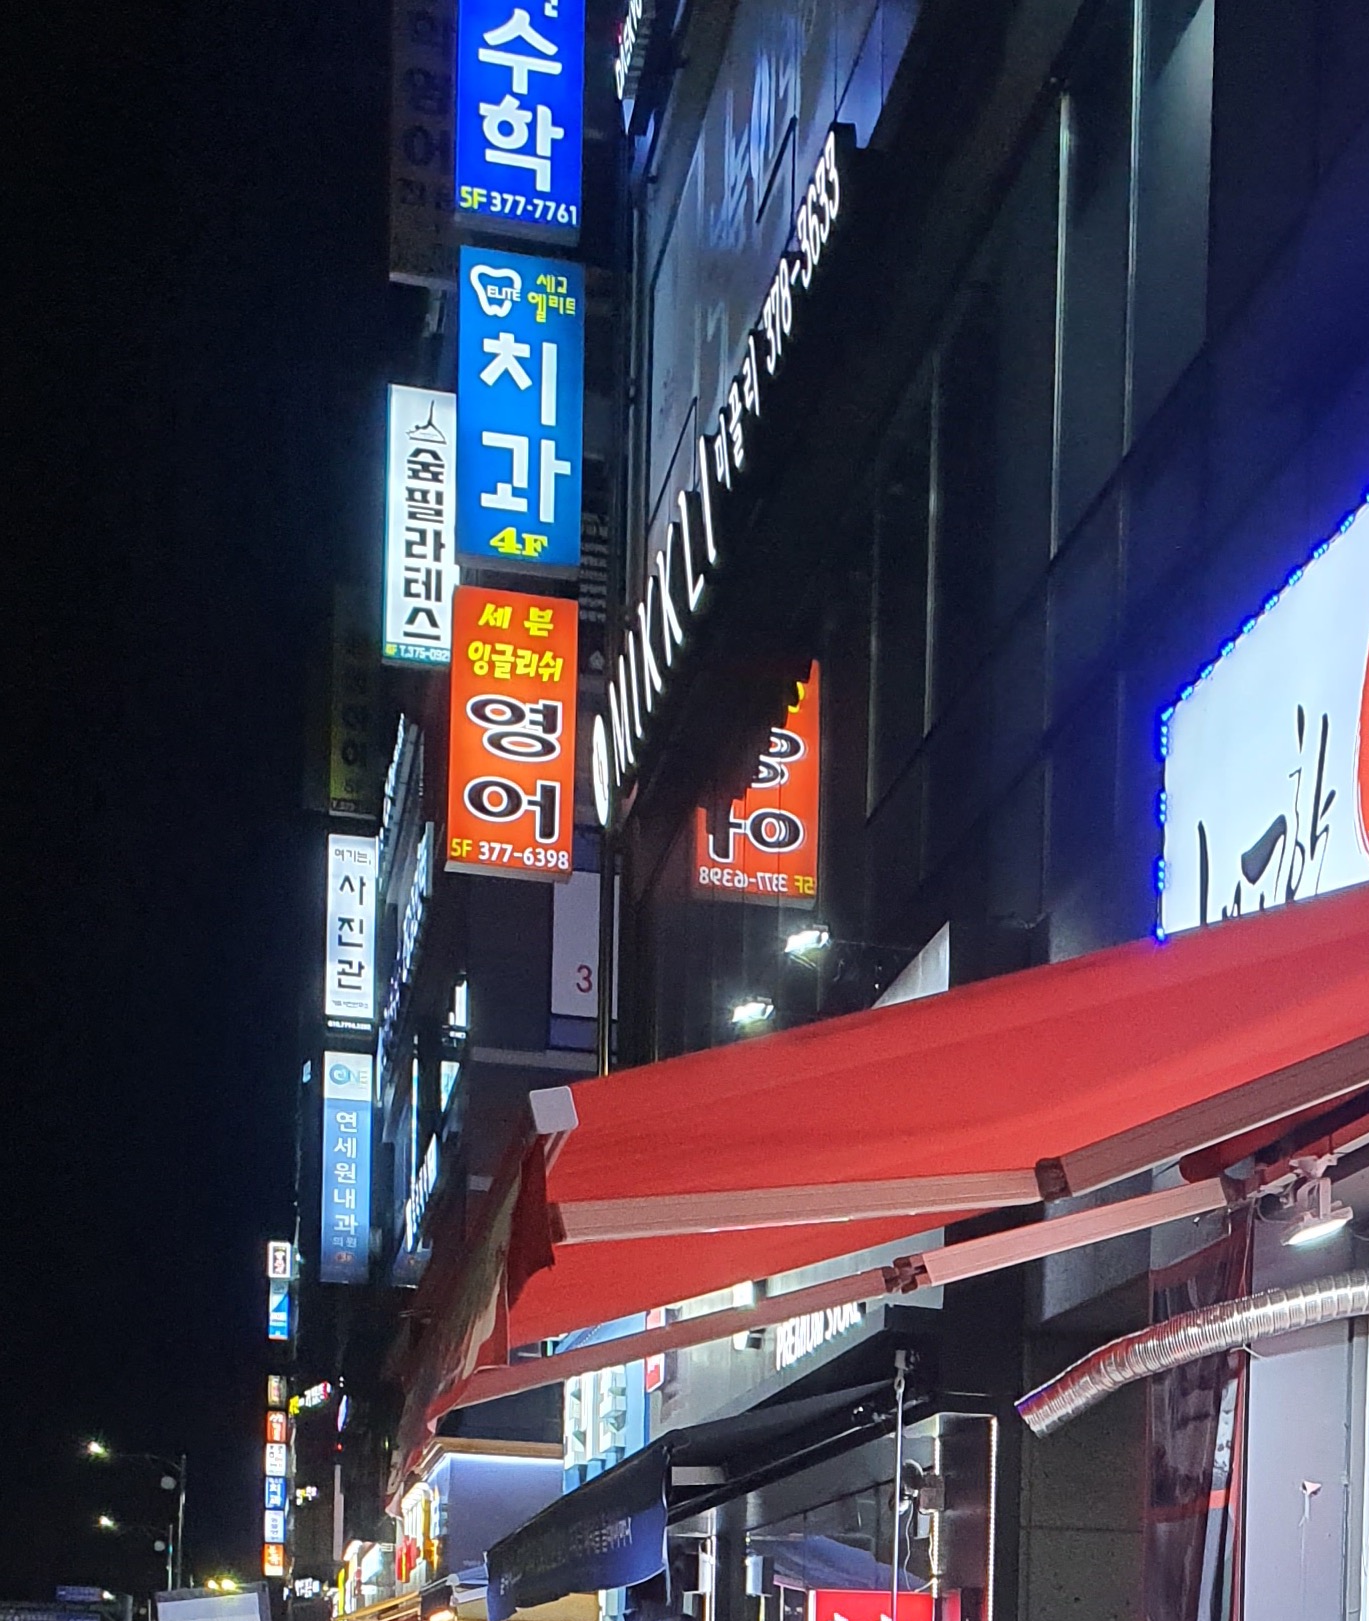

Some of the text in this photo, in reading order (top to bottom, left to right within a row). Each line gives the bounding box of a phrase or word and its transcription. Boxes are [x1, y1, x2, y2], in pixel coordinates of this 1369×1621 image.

[478, 8, 565, 193] 수학
[460, 185, 578, 226] 5F 377-7761
[763, 130, 840, 377] 378-3633
[486, 284, 521, 302] ELITE
[527, 291, 576, 323] 엘리트
[479, 332, 571, 524] 치과
[489, 528, 549, 558] 4F
[478, 601, 555, 638] 세븐
[466, 640, 564, 683] 잉글리쉬
[465, 694, 563, 845] 영어
[451, 838, 570, 869] 5F 377-6398
[337, 874, 367, 992] 사진관
[332, 1110, 359, 1236] 연세원내과
[775, 1309, 825, 1371] PREMIUM
